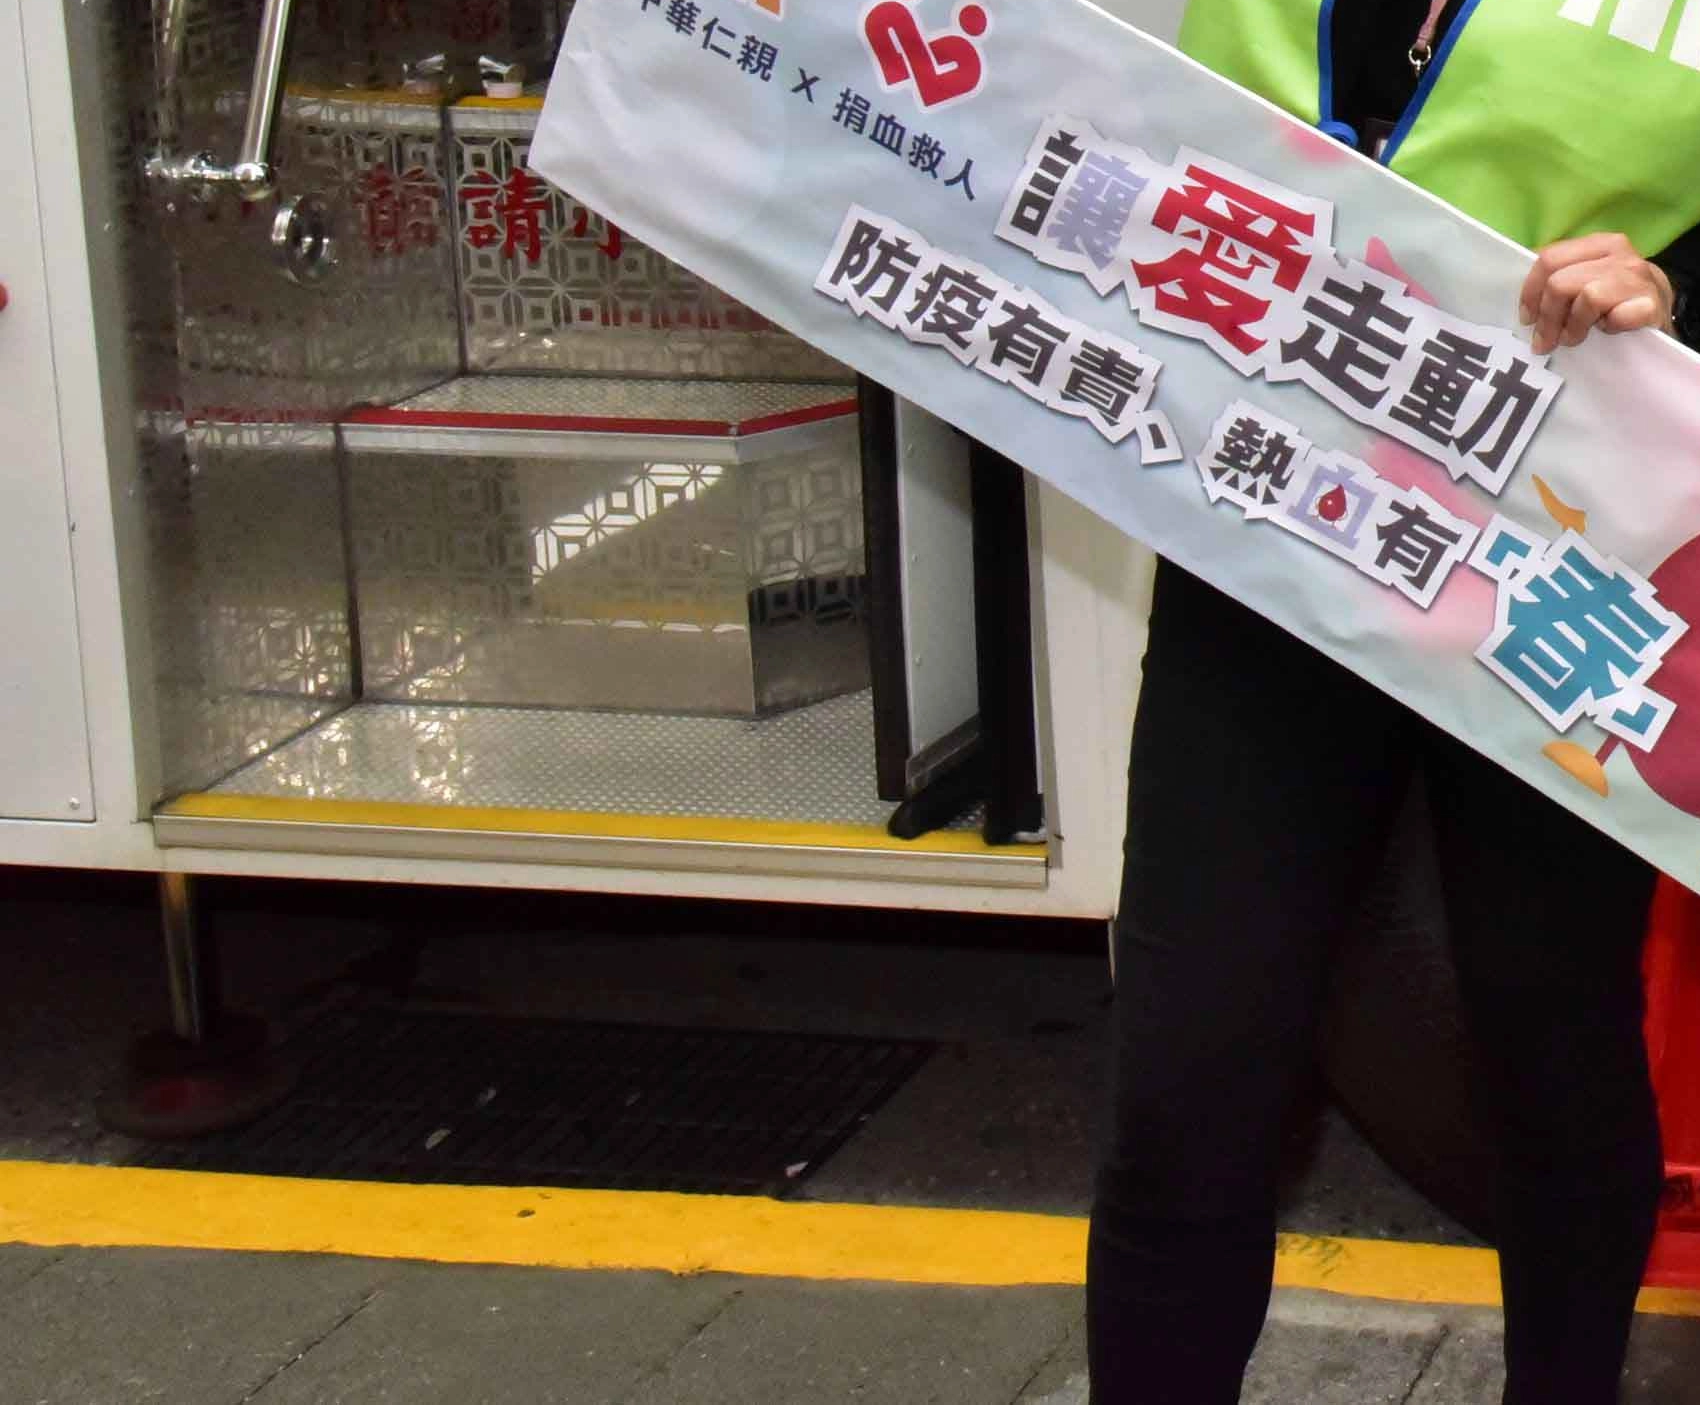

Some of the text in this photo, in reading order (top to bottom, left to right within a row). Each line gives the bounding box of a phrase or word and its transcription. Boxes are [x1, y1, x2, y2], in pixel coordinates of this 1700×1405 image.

[832, 87, 976, 202] 捐血救人
[1008, 129, 1552, 478] 讓愛走動
